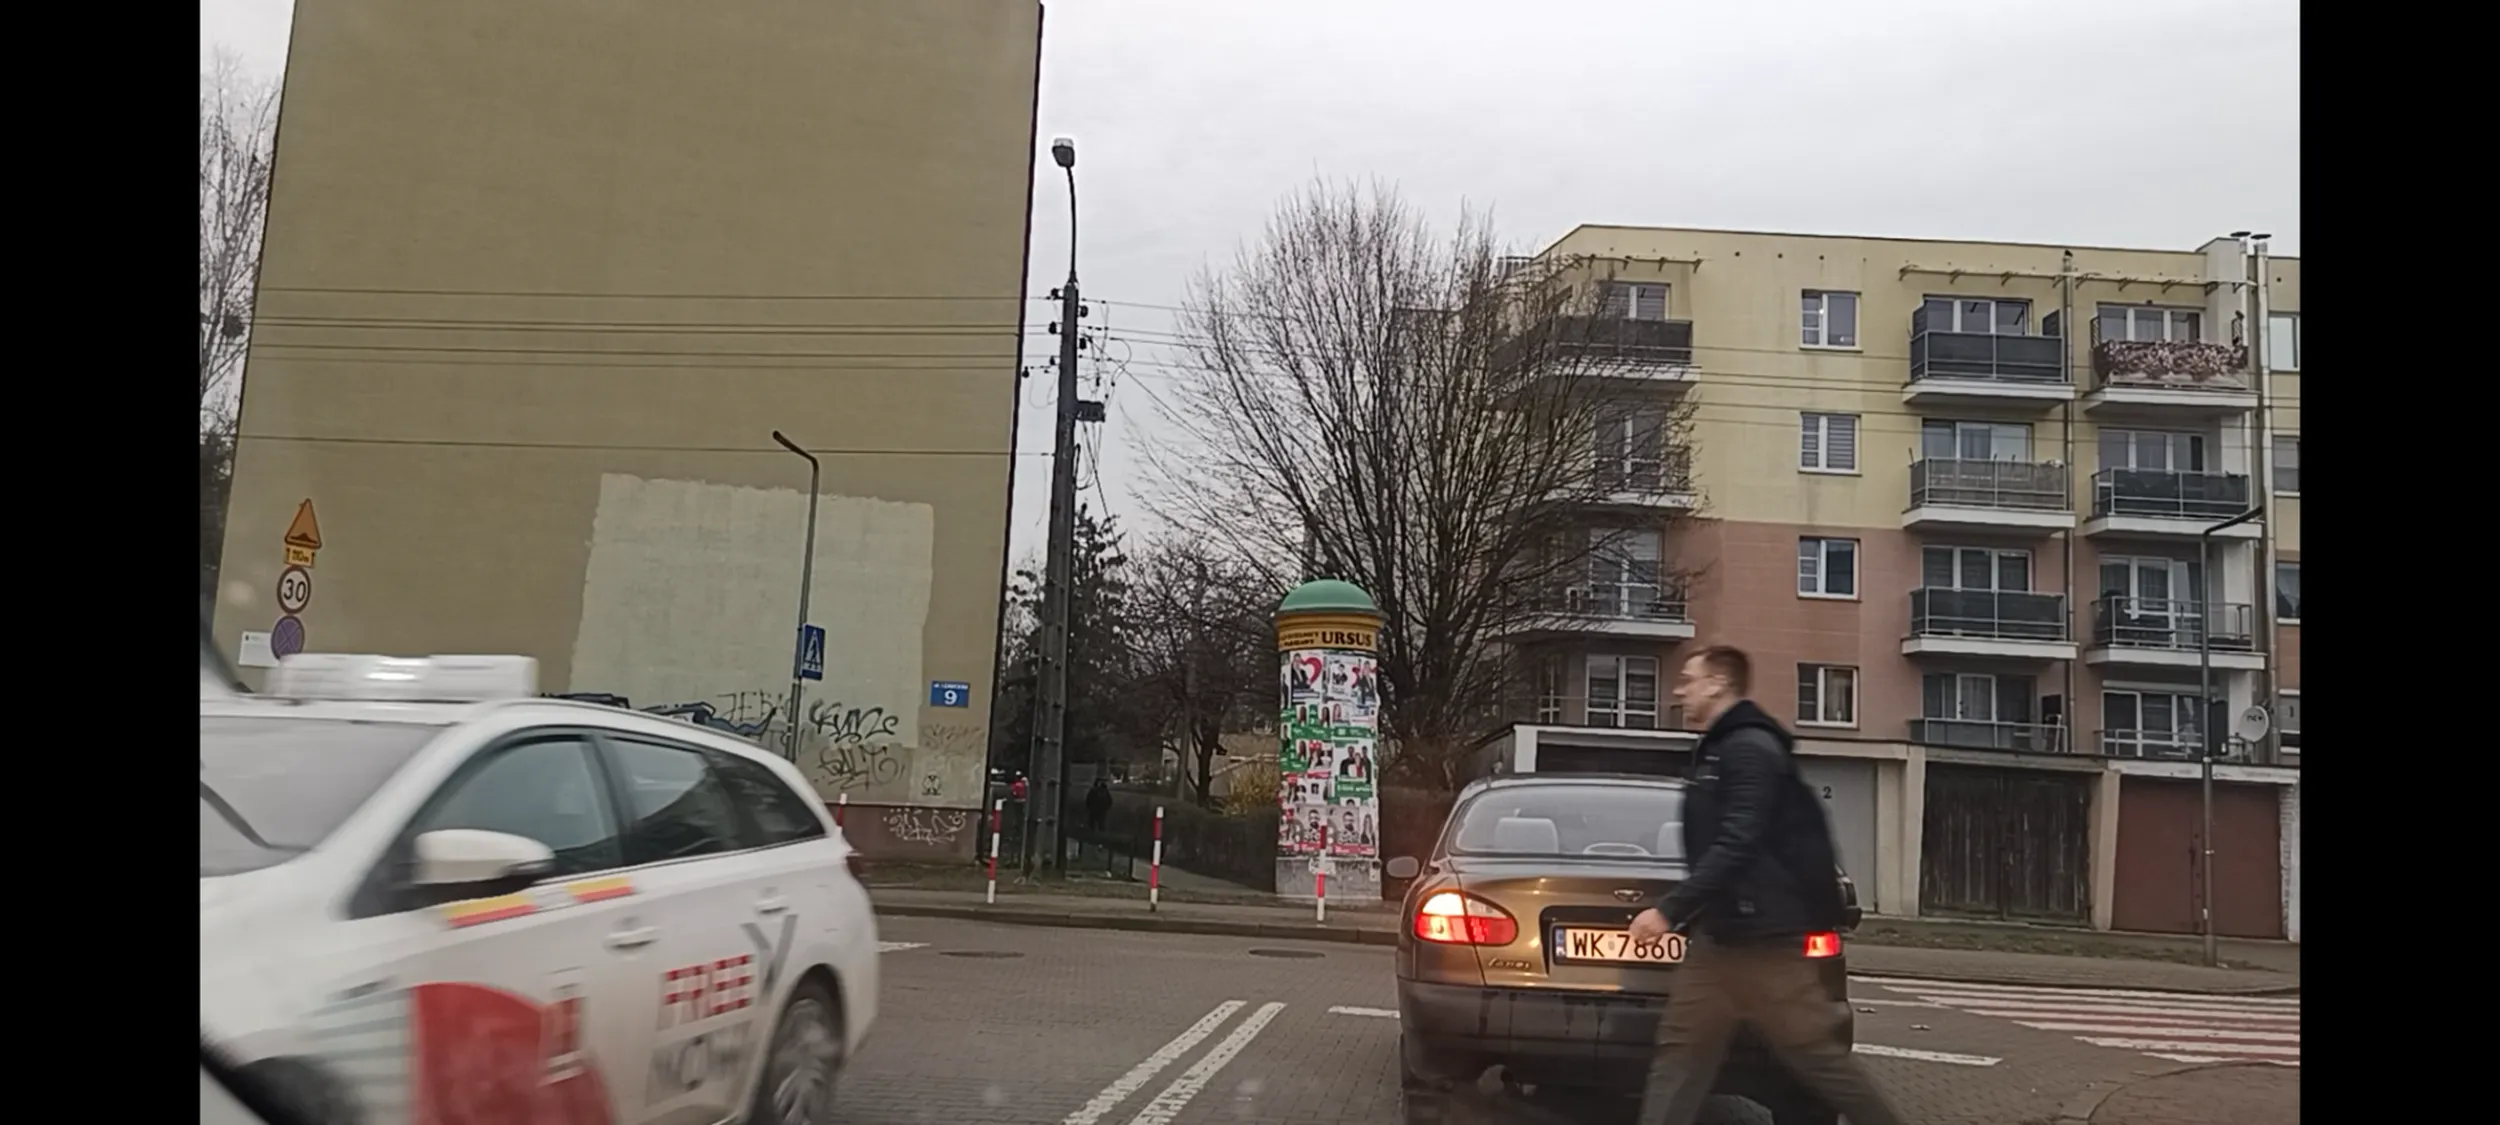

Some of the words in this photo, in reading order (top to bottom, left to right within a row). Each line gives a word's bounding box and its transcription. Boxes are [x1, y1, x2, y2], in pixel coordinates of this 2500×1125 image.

[283, 579, 306, 603] 30
[1321, 631, 1372, 647] URSUS
[944, 690, 957, 705] 9
[1823, 785, 1832, 799] 2
[1573, 931, 1605, 958] WK
